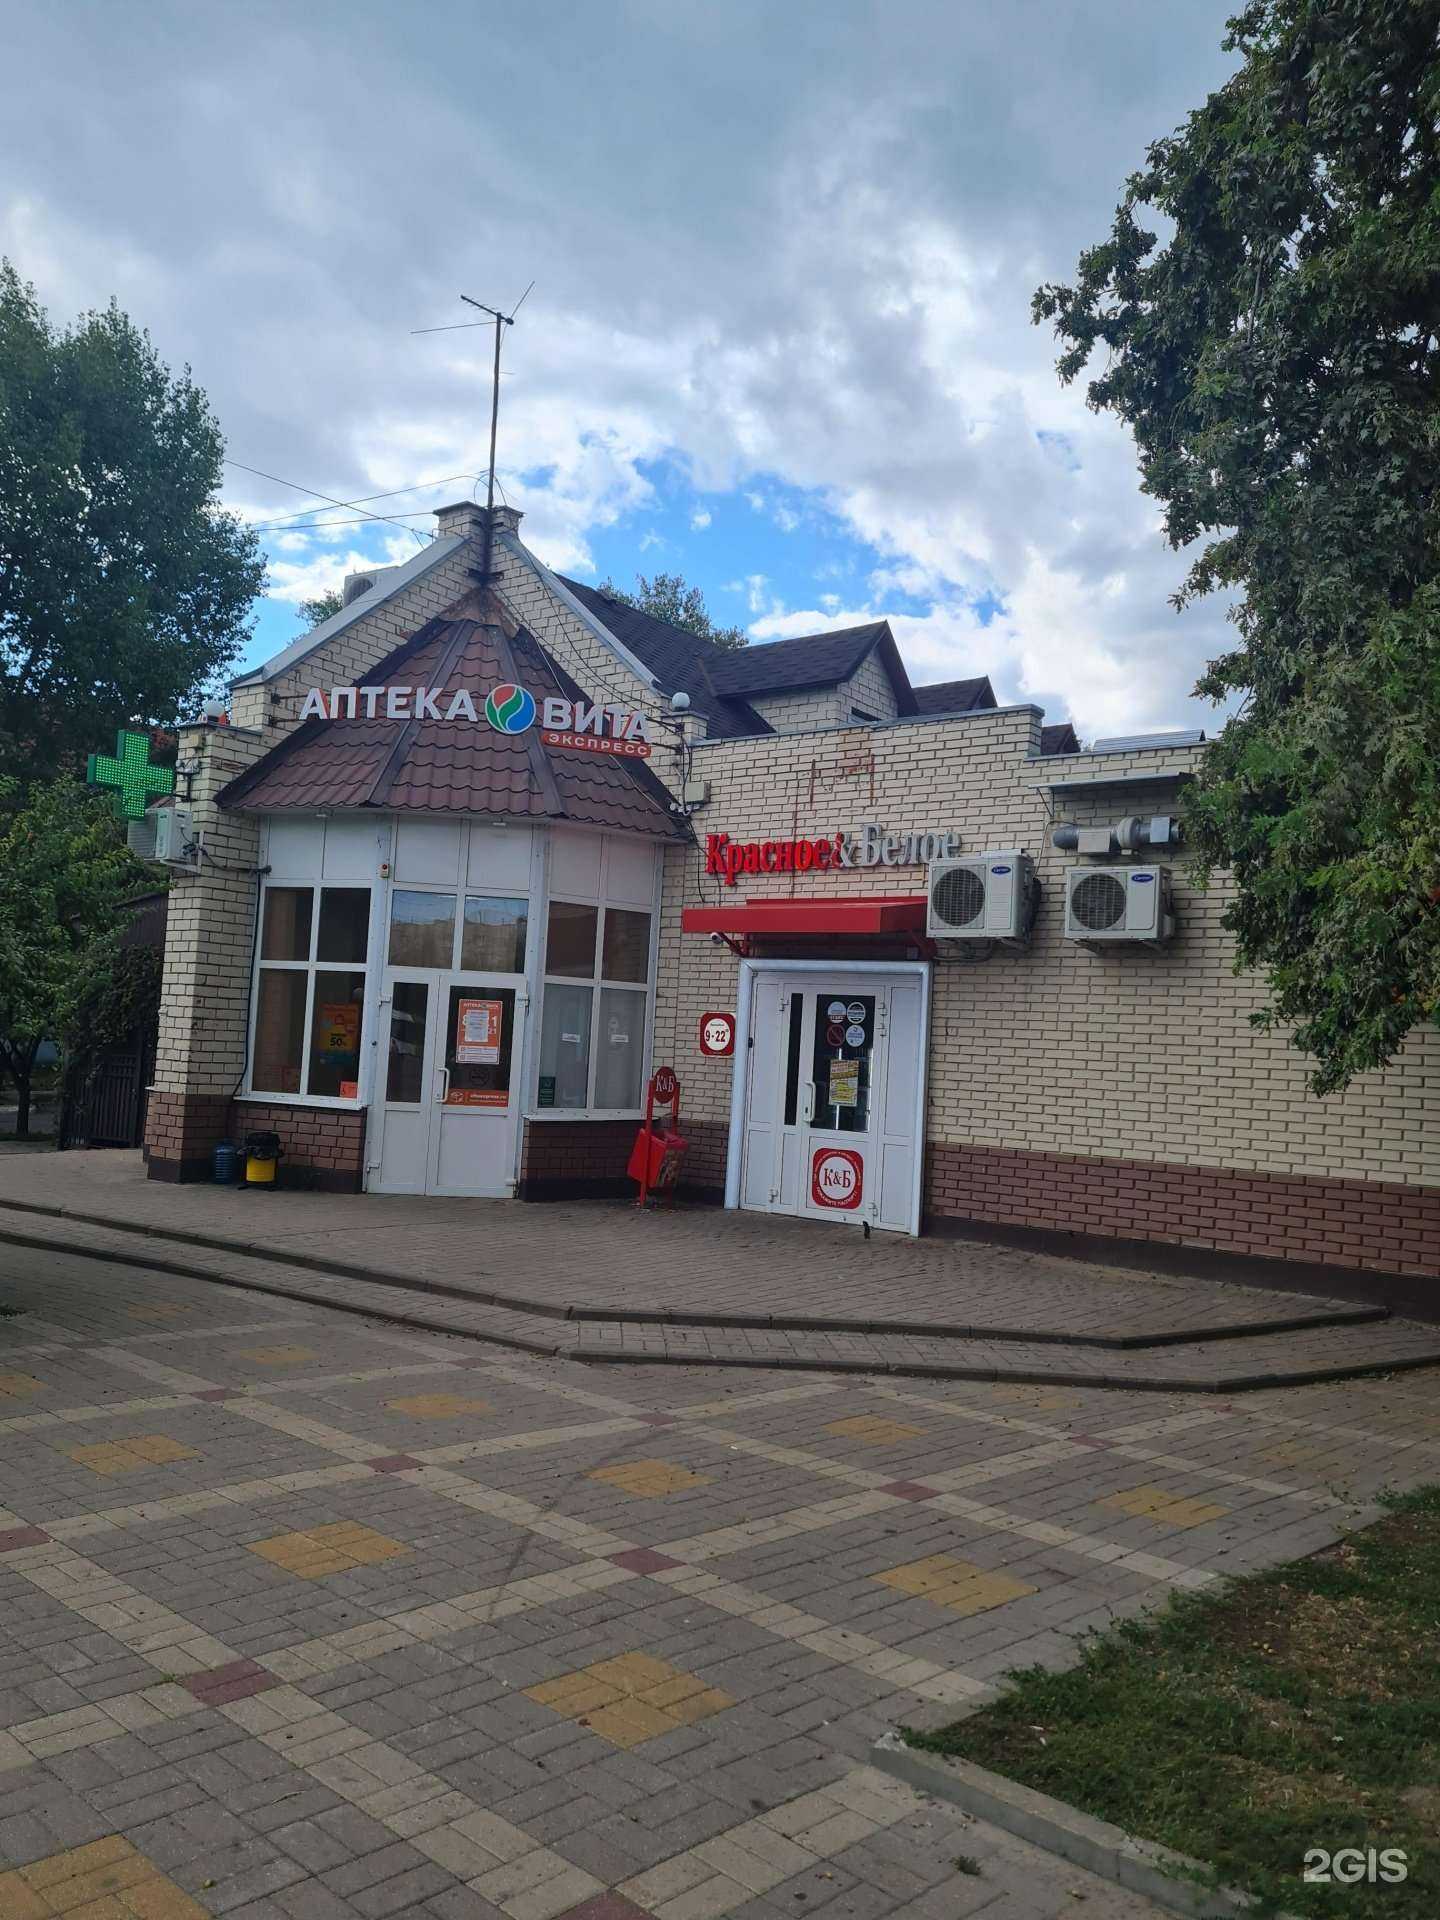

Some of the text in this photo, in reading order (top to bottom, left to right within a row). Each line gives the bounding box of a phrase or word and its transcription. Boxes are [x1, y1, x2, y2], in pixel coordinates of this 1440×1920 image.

[300, 686, 651, 743] АПТЕКА ВИТА
[548, 733, 648, 756] ЭКСПРЕСС
[655, 1075, 674, 1092] К&Б
[823, 1167, 851, 1188] К&Б
